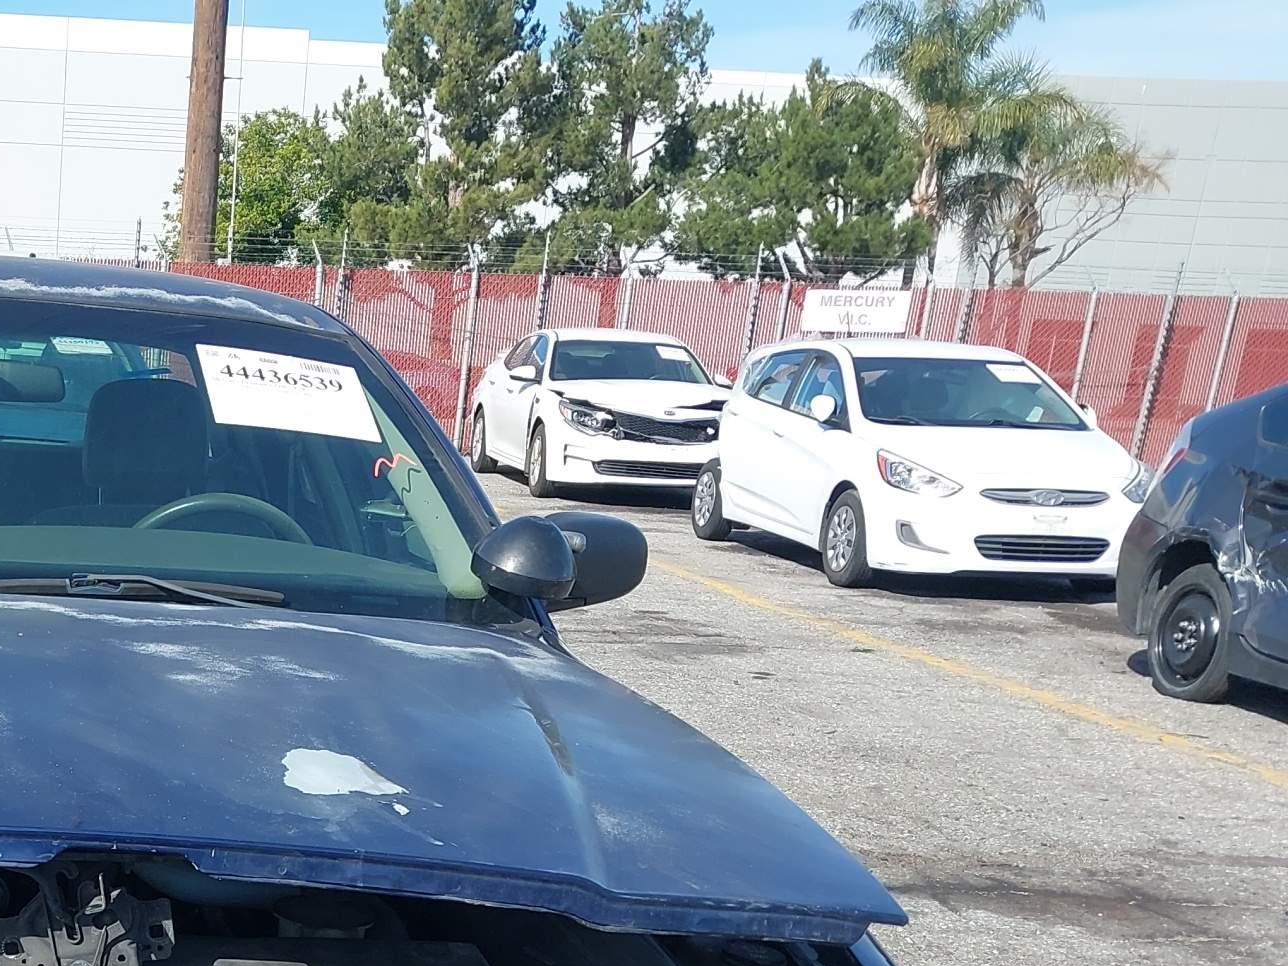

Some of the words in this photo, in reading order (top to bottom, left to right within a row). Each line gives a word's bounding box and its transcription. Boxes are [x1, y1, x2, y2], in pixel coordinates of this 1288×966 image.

[820, 295, 896, 308] MERCURY
[838, 313, 872, 326] V.I.C.
[219, 364, 344, 393] 44436539
